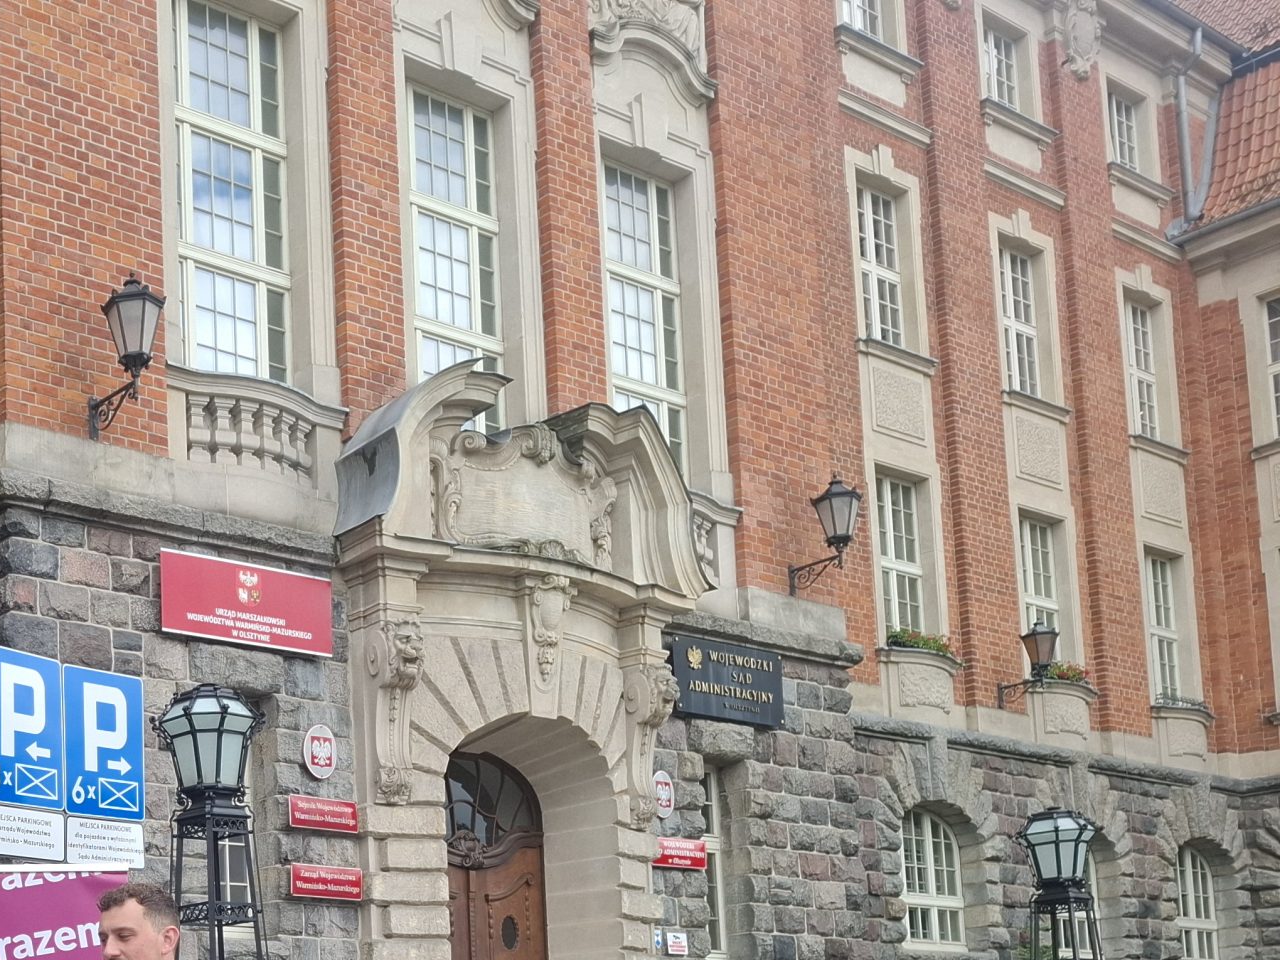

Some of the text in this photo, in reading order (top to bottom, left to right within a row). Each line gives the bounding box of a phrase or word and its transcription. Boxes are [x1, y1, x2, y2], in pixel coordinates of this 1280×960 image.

[186, 612, 312, 640] WOJEWÓDZTWA WARMIŃSKO-MAZURSKIEGO
[215, 607, 286, 626] URZĄD MARSZAŁKOWSKI
[239, 631, 270, 642] OLSZTYNIE
[689, 680, 774, 704] ADMINISTRACYJNY
[0, 661, 46, 757] P
[83, 682, 127, 772] P
[17, 817, 52, 827] PARKINGOWE
[100, 824, 132, 832] PARKINGOWE
